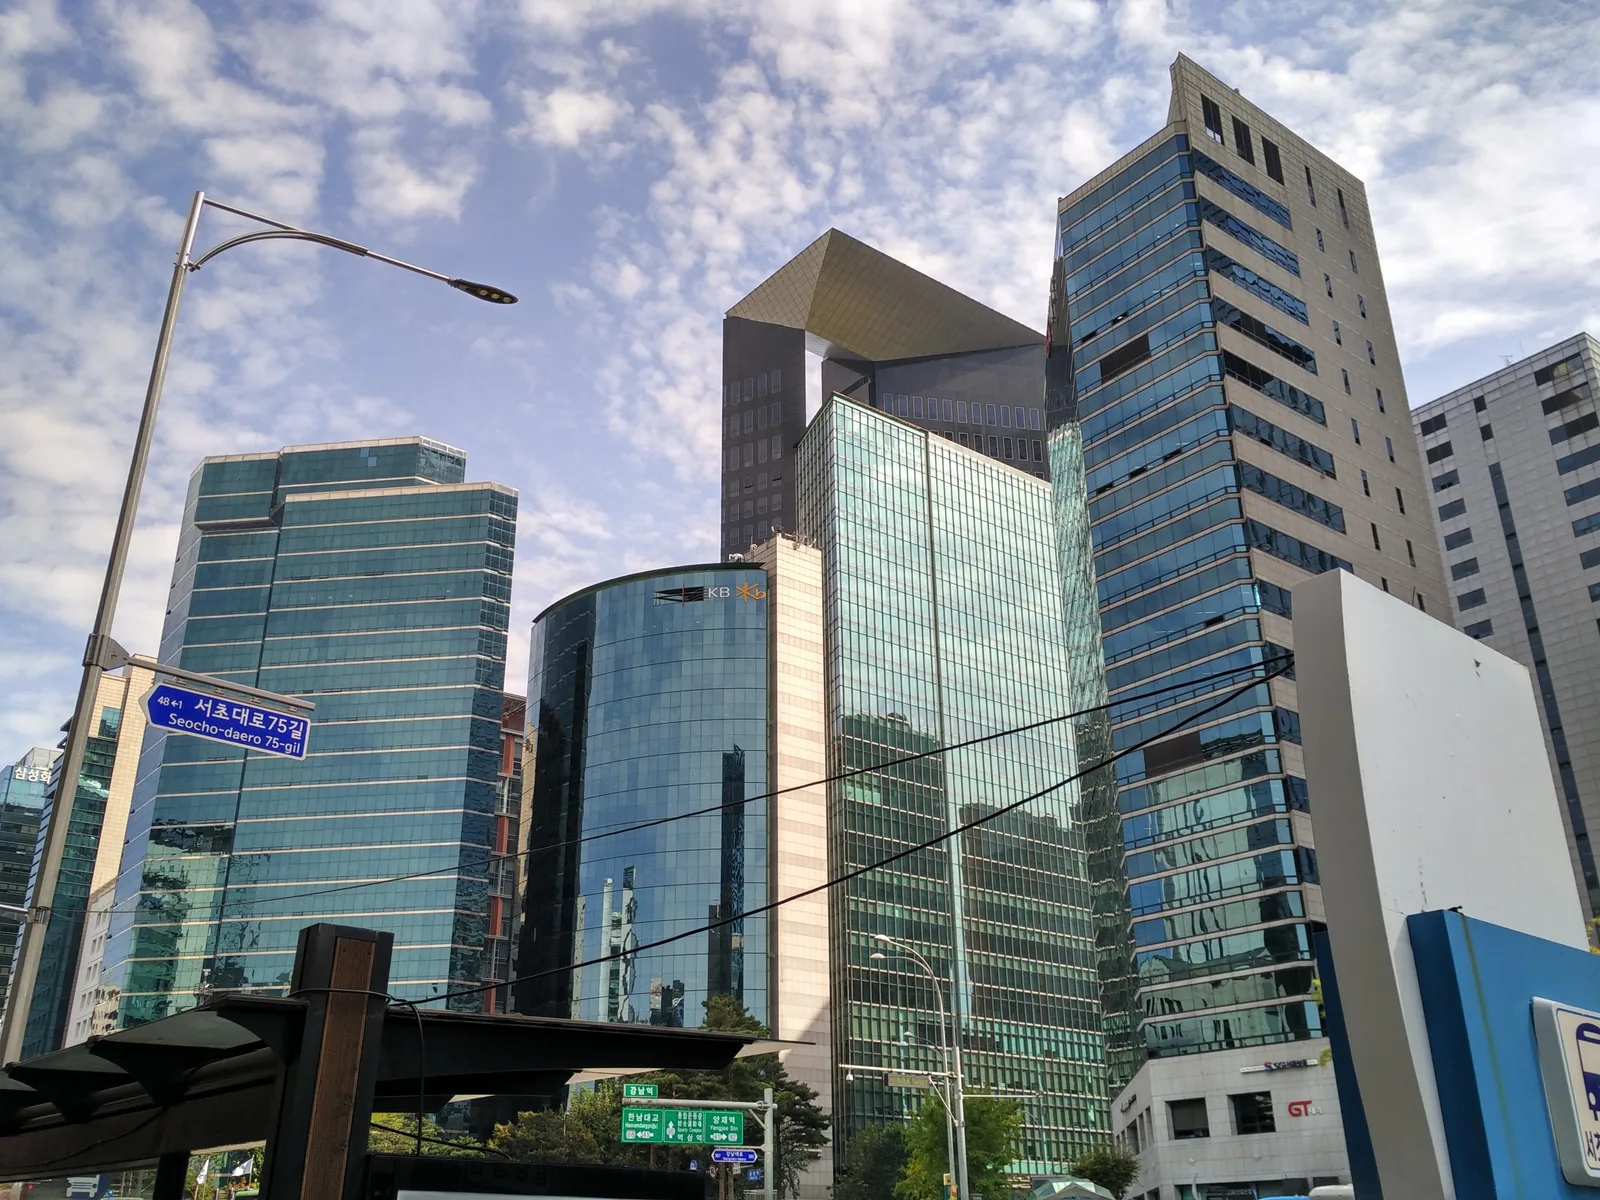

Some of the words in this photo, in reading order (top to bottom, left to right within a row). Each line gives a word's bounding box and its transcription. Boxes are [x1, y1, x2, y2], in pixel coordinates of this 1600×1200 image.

[708, 587, 730, 598] KB
[194, 698, 304, 740] 서초대로75길
[168, 712, 262, 745] Seocho-daero
[265, 734, 301, 754] 75-gil
[630, 1086, 654, 1096] 강남역
[628, 1112, 660, 1122] 한남대교
[712, 1115, 736, 1125] 양재역
